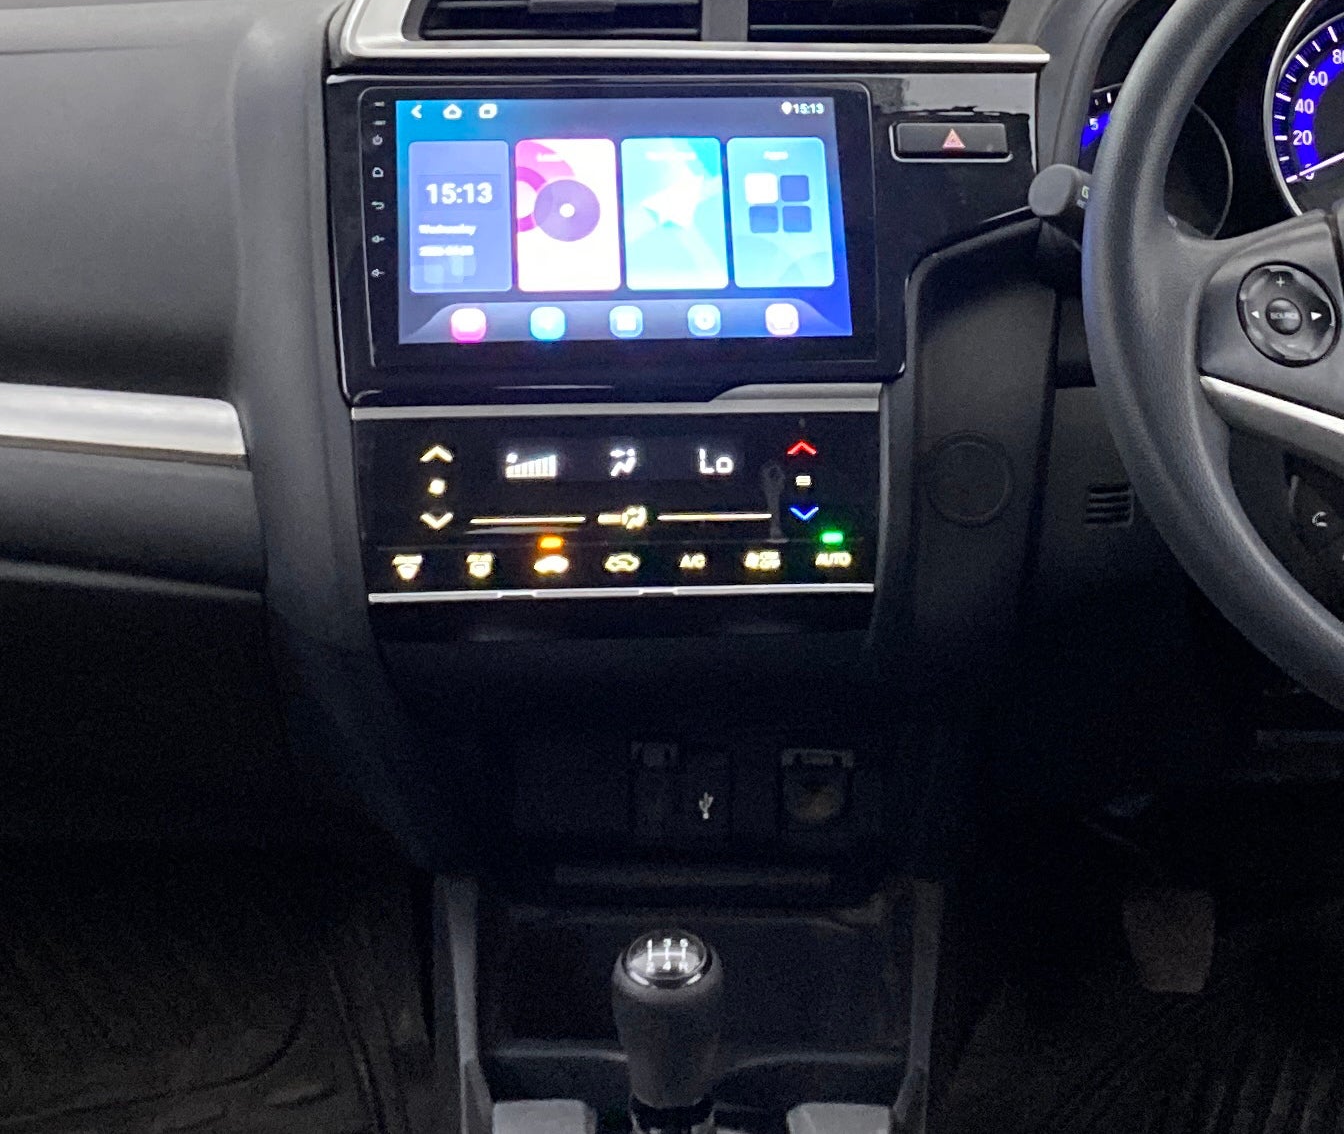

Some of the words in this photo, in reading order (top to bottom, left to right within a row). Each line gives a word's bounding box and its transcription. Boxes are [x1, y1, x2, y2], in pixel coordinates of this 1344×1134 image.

[1308, 71, 1328, 86] 60
[792, 103, 824, 114] 15:13
[1295, 99, 1314, 114] 40
[1293, 130, 1312, 145] 20
[425, 181, 493, 205] 15:13
[698, 448, 735, 474] Lo
[815, 552, 852, 567] AUTO
